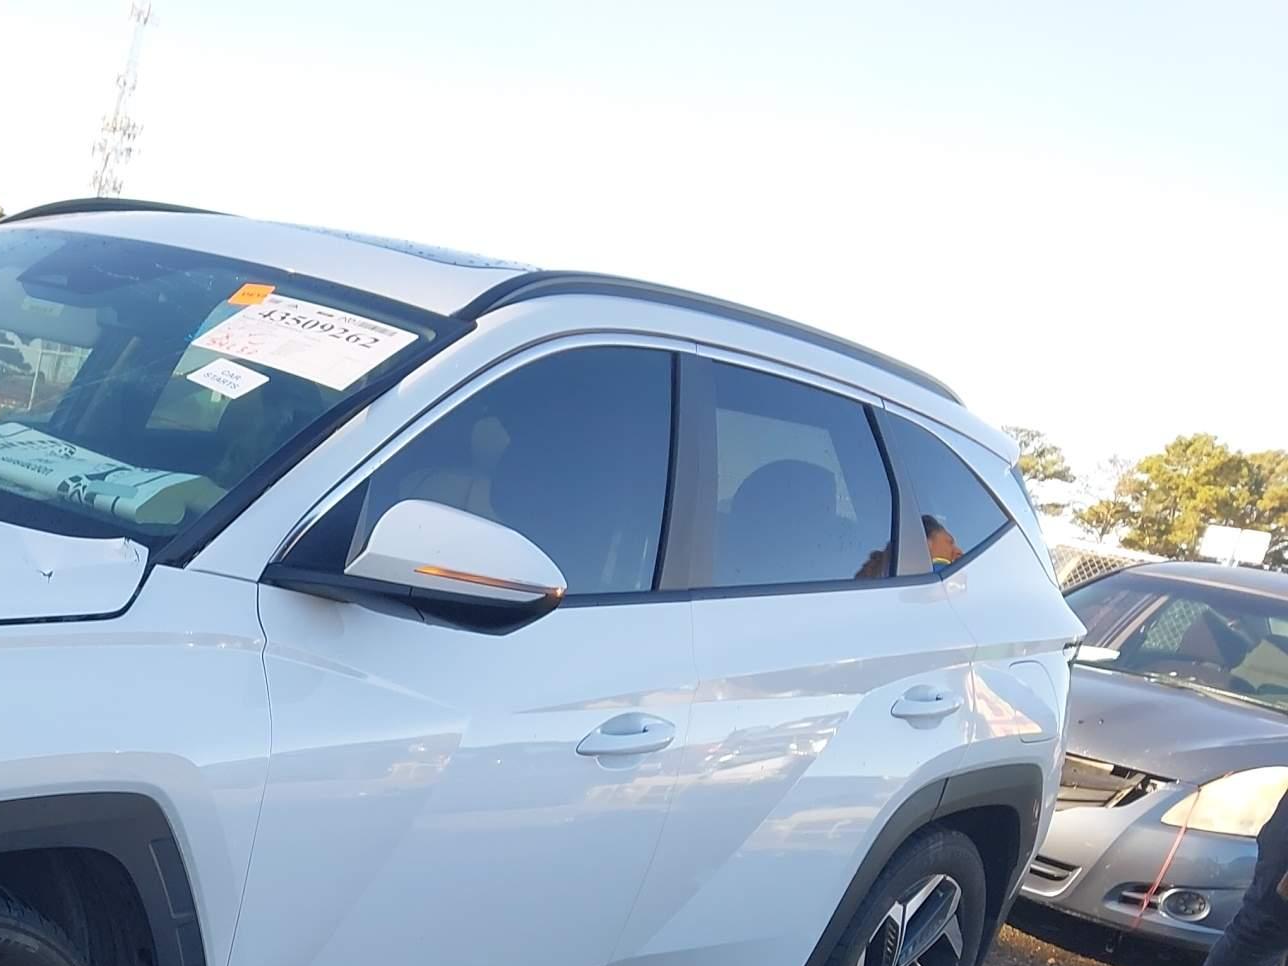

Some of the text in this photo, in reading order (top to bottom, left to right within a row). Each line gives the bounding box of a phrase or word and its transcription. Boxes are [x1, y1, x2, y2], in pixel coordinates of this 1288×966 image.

[257, 308, 380, 349] 43509262
[201, 370, 241, 390] STARTS
[219, 368, 243, 381] CAR
